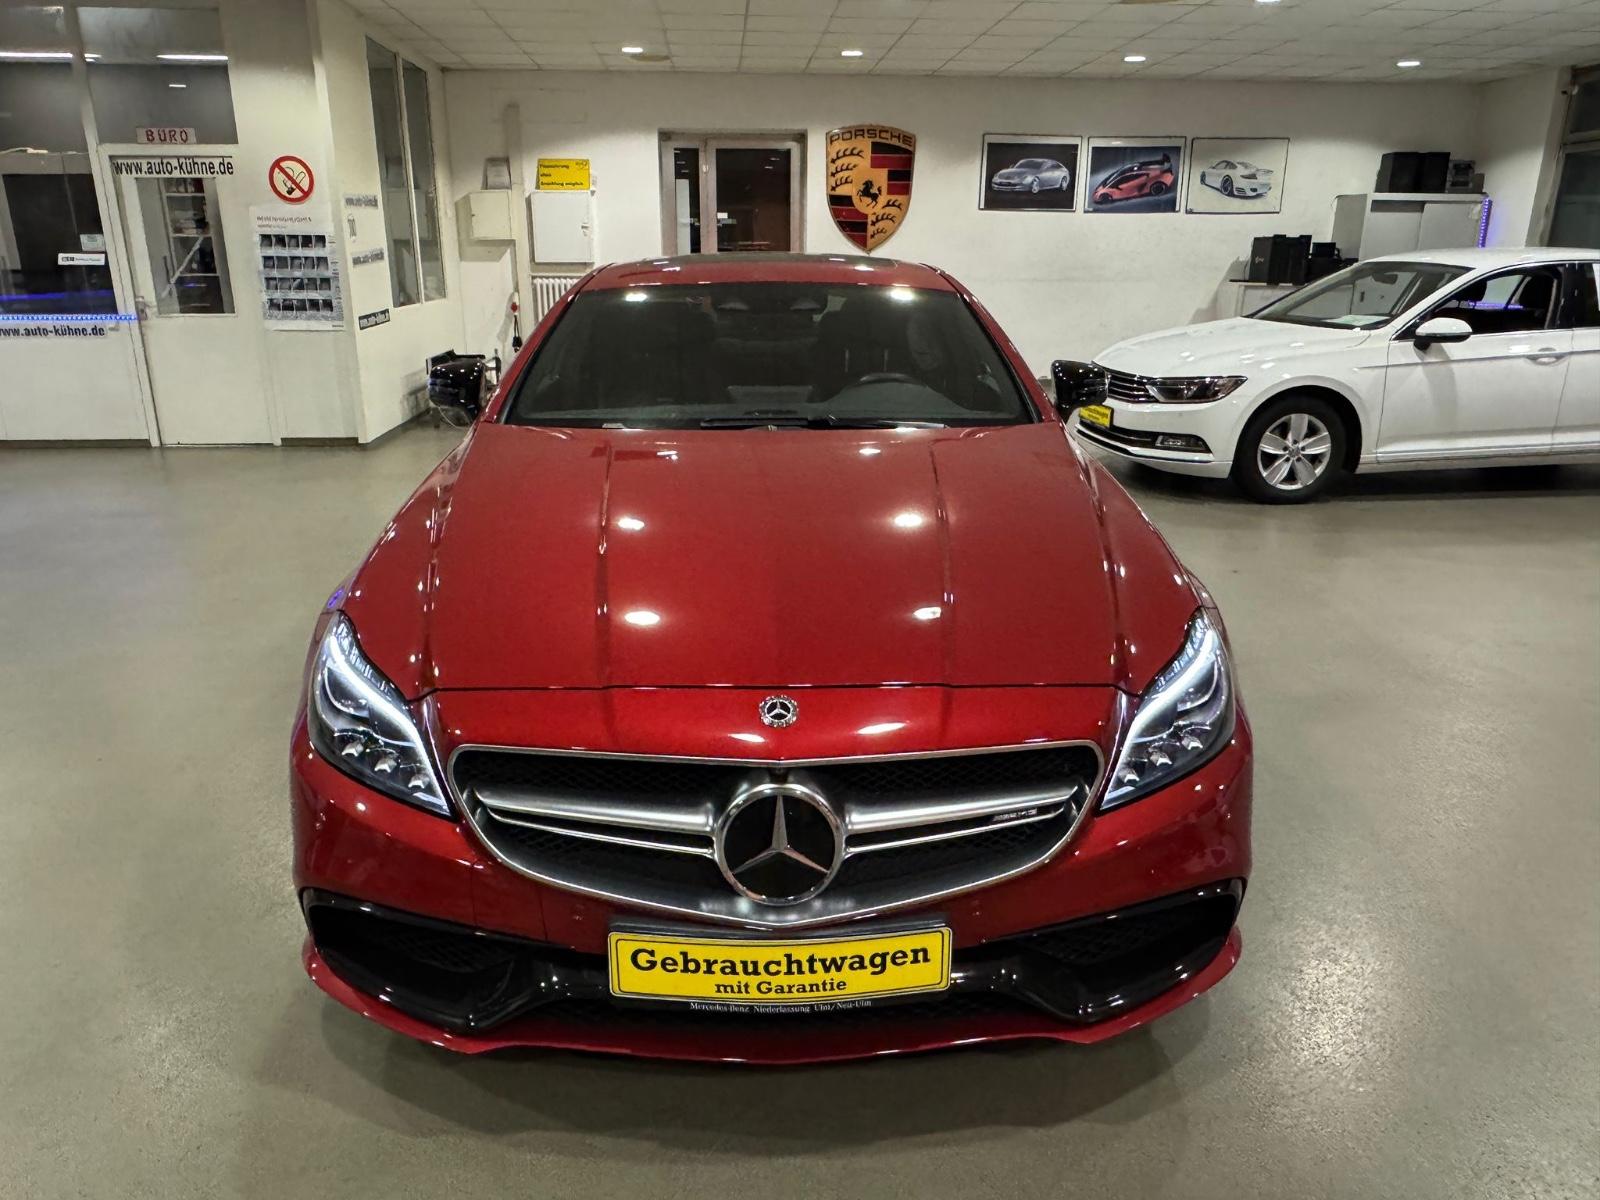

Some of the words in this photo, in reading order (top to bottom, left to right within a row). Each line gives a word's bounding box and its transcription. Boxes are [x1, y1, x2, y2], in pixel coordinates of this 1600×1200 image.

[829, 127, 913, 148] PORSCHE
[112, 157, 234, 176] www.auto-kühne.de
[630, 946, 931, 976] Gebrauchtwagen
[715, 980, 750, 995] mit
[756, 978, 848, 995] Garantie
[753, 1005, 810, 1014] Niederlassung
